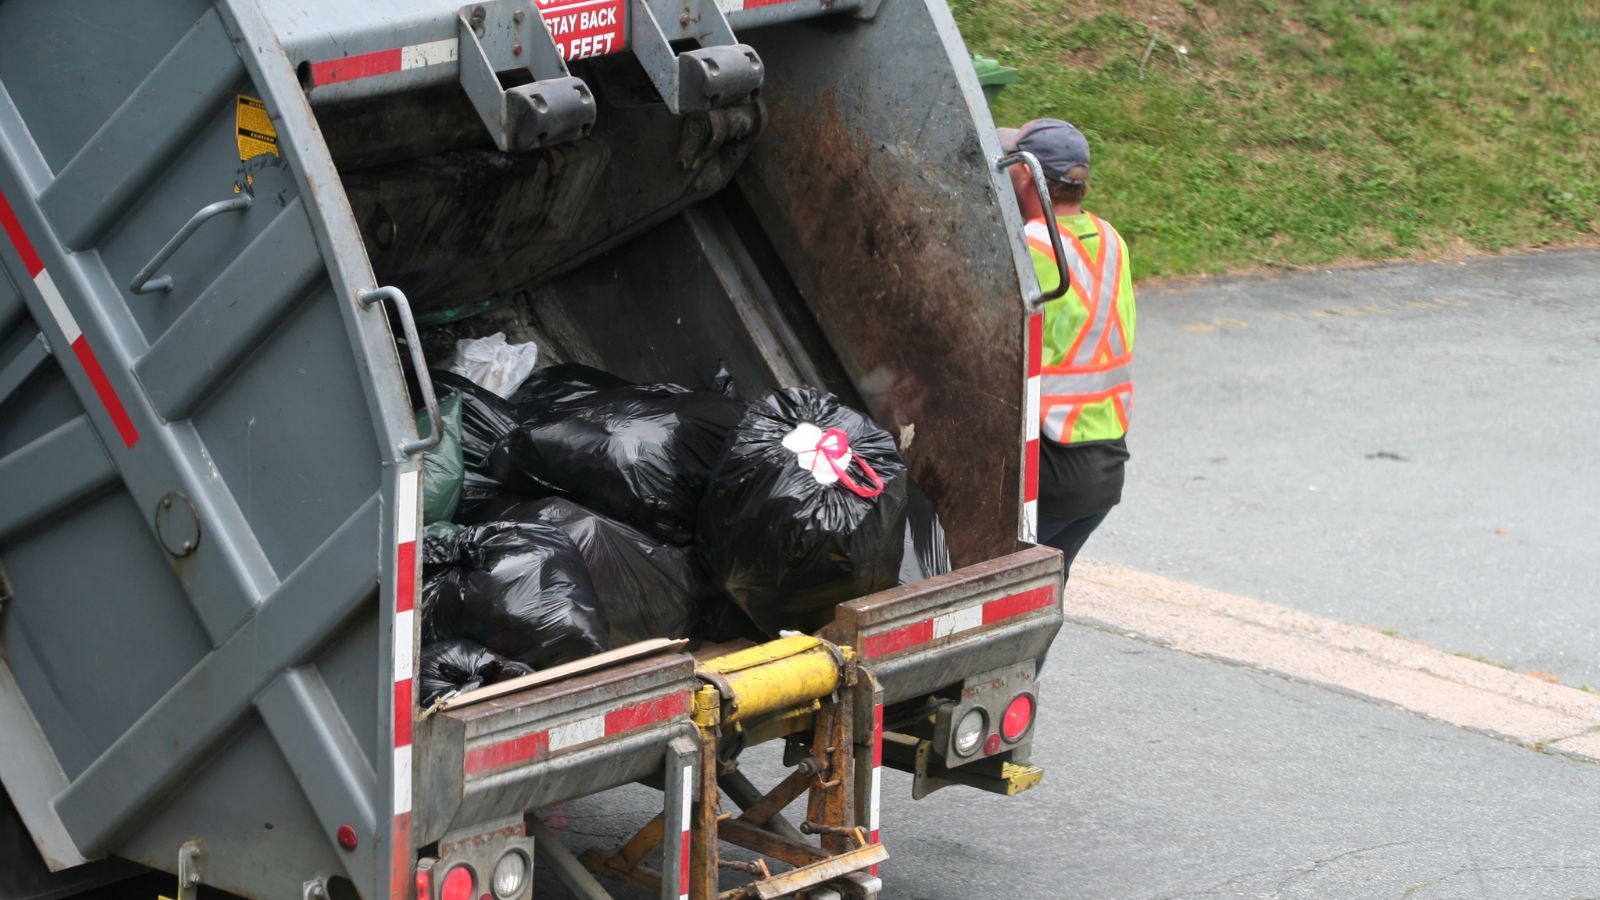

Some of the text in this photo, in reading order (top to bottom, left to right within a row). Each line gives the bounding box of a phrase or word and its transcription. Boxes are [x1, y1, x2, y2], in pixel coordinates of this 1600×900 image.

[545, 7, 616, 35] STAY BACK
[568, 32, 615, 61] FEET
